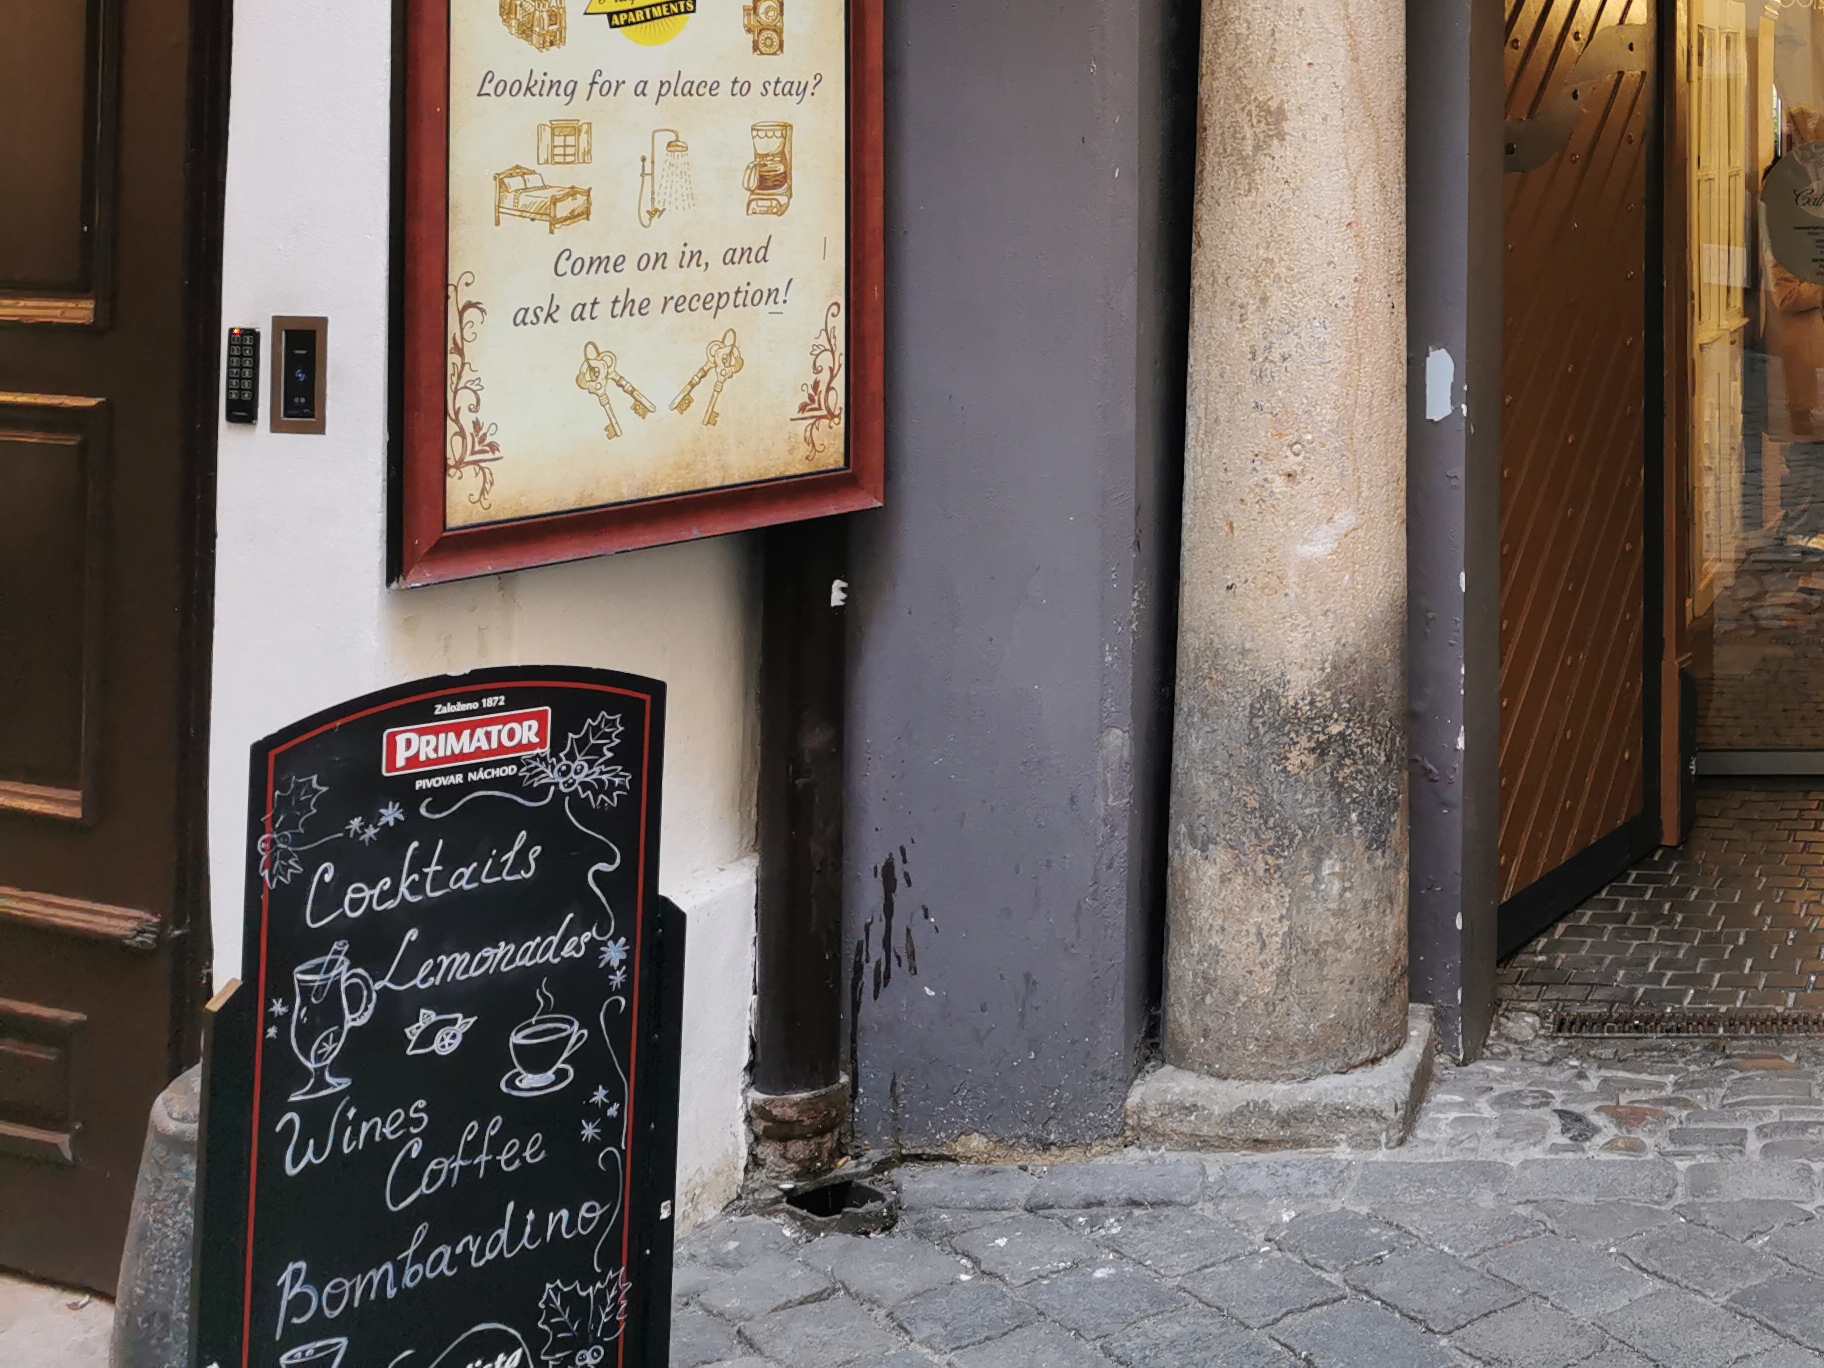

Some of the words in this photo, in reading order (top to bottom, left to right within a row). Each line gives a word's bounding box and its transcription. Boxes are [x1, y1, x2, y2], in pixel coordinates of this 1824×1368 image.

[611, 0, 694, 26] APARTMENTS
[476, 68, 579, 106] Looking
[586, 69, 626, 101] for
[633, 79, 648, 98] a
[655, 70, 720, 106] place
[730, 76, 751, 98] to
[760, 72, 823, 105] stay?
[553, 248, 626, 277] Come
[636, 251, 668, 272] on
[678, 242, 710, 273] in,
[722, 234, 772, 266] and
[512, 293, 560, 327] ask
[570, 297, 599, 322] at
[610, 287, 650, 318] the
[661, 277, 793, 320] reception!
[433, 700, 480, 716] Založeno
[481, 695, 506, 709] 1872
[415, 772, 464, 791] PIVOVAR
[467, 764, 518, 783] NÁCHOD
[305, 830, 542, 929] Cocktails
[374, 913, 592, 990] Lemonades
[275, 1096, 429, 1177] Wines
[385, 1115, 548, 1212] Coffee
[275, 1201, 610, 1342] Bombardino
